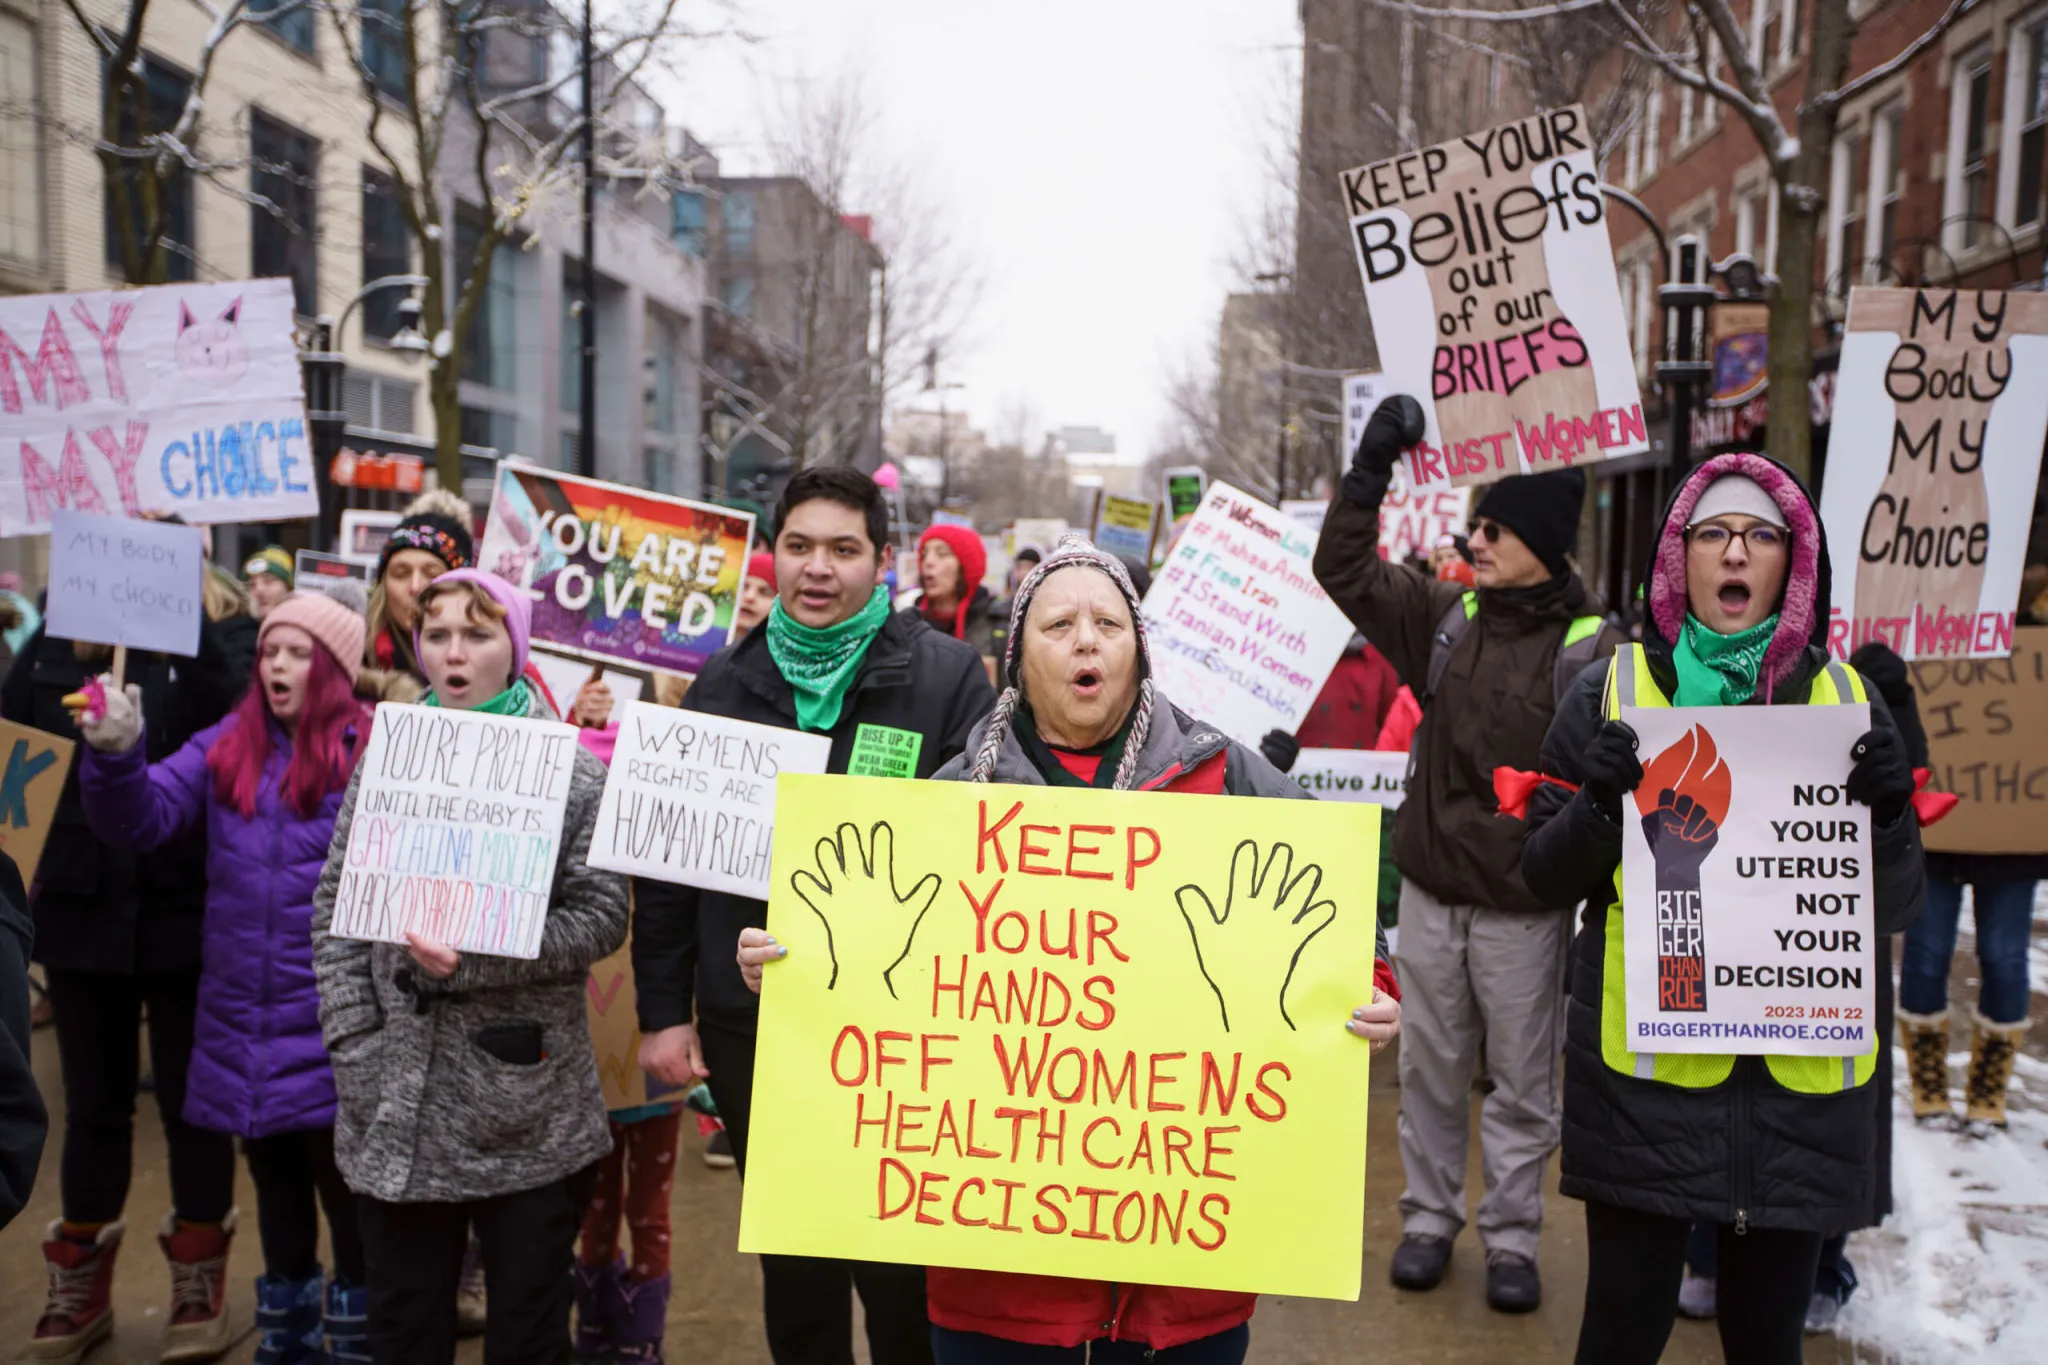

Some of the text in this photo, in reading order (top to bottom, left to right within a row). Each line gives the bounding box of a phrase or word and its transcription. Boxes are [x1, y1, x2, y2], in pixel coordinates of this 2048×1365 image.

[1345, 108, 1587, 216] KEEP YOUR
[1356, 161, 1603, 283] Beliefs
[1449, 246, 1516, 293] out
[1439, 288, 1554, 336] of our
[0, 298, 135, 415] MY
[1431, 317, 1589, 400] BRIEFS
[1402, 432, 1511, 486] TRUST
[1516, 403, 1647, 465] WOMEN
[20, 418, 150, 525] MY
[160, 418, 309, 500] CHOICE
[68, 530, 108, 556] MY
[527, 509, 726, 587] YOU ARE
[1860, 493, 1990, 568] Choice
[62, 573, 97, 599] MY
[519, 556, 716, 636] LOVED
[1915, 602, 2016, 656] WOMEN
[861, 727, 885, 745] RISE
[887, 731, 904, 747] UP
[1928, 700, 2013, 740] IS
[381, 710, 474, 788] YOU'RE
[636, 715, 781, 780] WOMENS
[627, 758, 764, 806] RIGHTS ARE
[1290, 769, 1364, 792] ctive
[1925, 759, 2048, 803] ALTHC
[364, 787, 421, 819] UNTIL
[425, 793, 461, 822] THE
[464, 798, 519, 827] BABY
[612, 788, 775, 883] HUMAN RIGH
[976, 800, 1162, 891] KEEP
[1769, 820, 1859, 843] YOUR
[1736, 856, 1861, 879] UTERUS
[959, 878, 1130, 966] YOUR
[1657, 889, 1701, 924] BIG
[1796, 892, 1861, 915] NOT
[1658, 923, 1702, 957] GER
[1774, 929, 1862, 952] YOUR
[1660, 956, 1703, 979] THAN
[1714, 965, 1863, 989] DECISION
[931, 954, 1117, 1032] HANDS
[1660, 976, 1704, 1009] ROE
[1764, 1005, 1863, 1019] 2023 JAN 22
[1638, 1021, 1864, 1041] BIGGERTHANROE.COM
[830, 1024, 1293, 1122] OFF WOMENS
[878, 1157, 1232, 1251] DECISIONS
